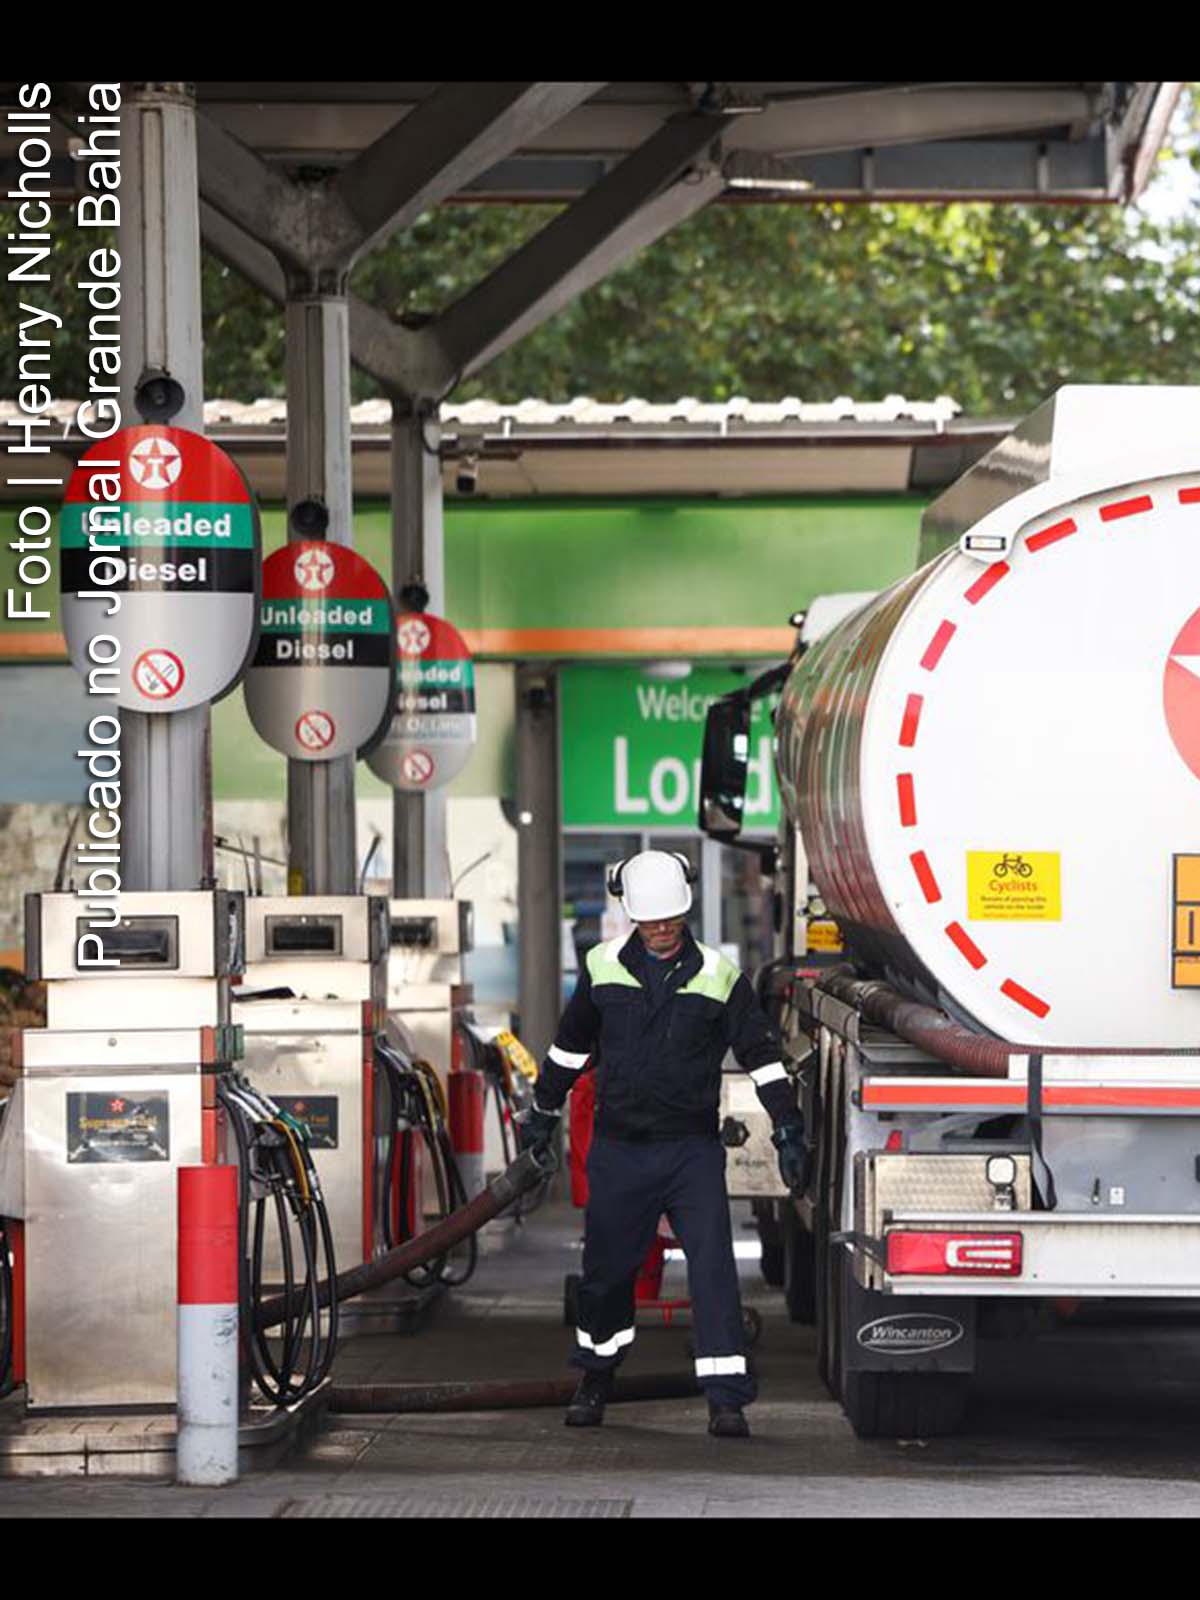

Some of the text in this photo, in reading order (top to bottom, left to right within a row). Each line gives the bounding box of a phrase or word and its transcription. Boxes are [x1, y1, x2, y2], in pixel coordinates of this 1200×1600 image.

[260, 605, 373, 625] Unleaded
[276, 639, 354, 660] Diesel
[398, 691, 448, 711] iesel
[636, 684, 763, 722] Welce
[988, 879, 1038, 894] Cyclists
[872, 1326, 953, 1340] Wincanton
